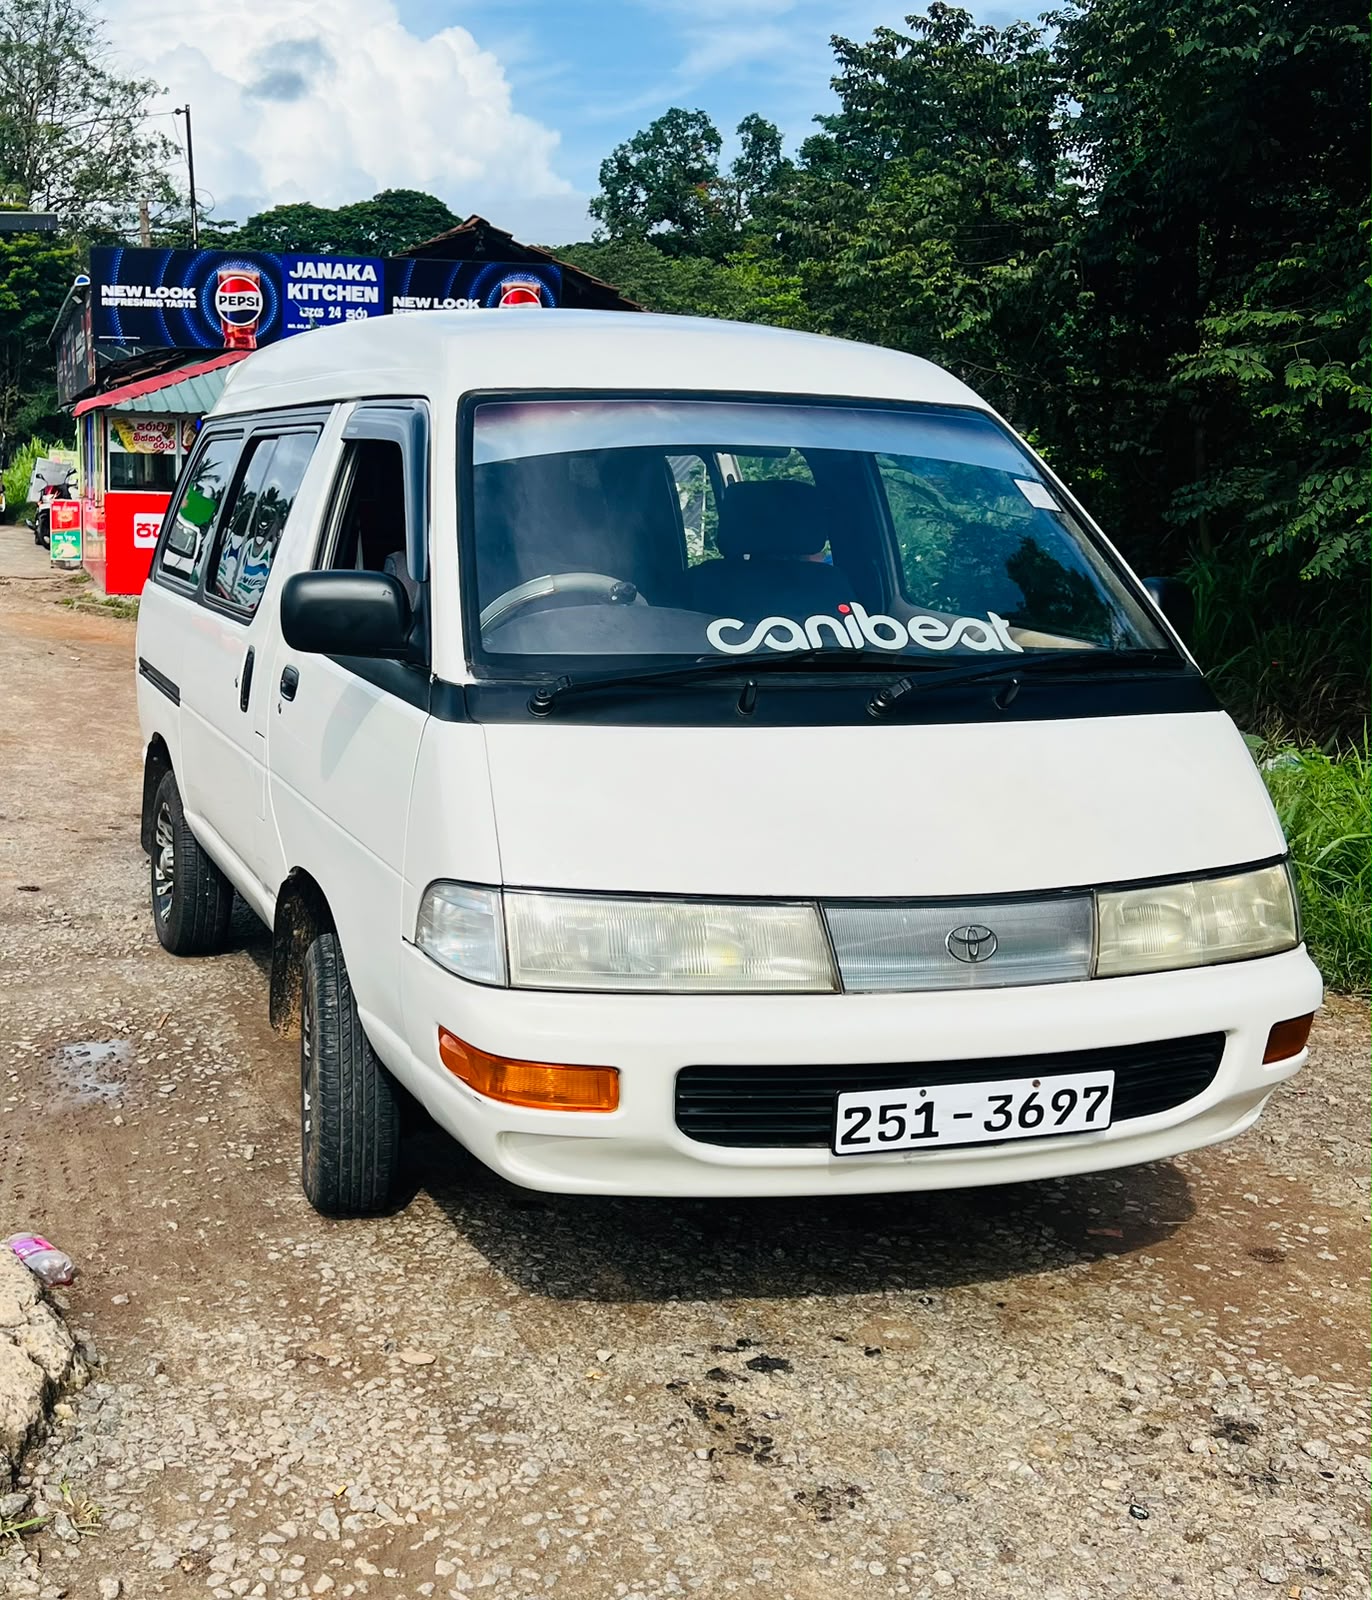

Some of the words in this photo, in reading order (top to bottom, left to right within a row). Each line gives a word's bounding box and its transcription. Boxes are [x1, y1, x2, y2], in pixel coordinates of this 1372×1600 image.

[289, 262, 377, 281] JANAKA
[101, 285, 143, 298] NEW
[144, 287, 196, 299] LOOK
[287, 283, 379, 303] KITCHEN
[101, 298, 163, 307] REFRESHING
[165, 299, 197, 308] TASTE
[218, 295, 260, 307] PEPSI
[393, 296, 431, 308] NEW
[433, 298, 480, 310] LOOK
[328, 306, 342, 319] 24
[136, 421, 168, 431] පරාටා
[706, 602, 1024, 654] canibeat
[841, 1085, 1109, 1146] 251-3697
